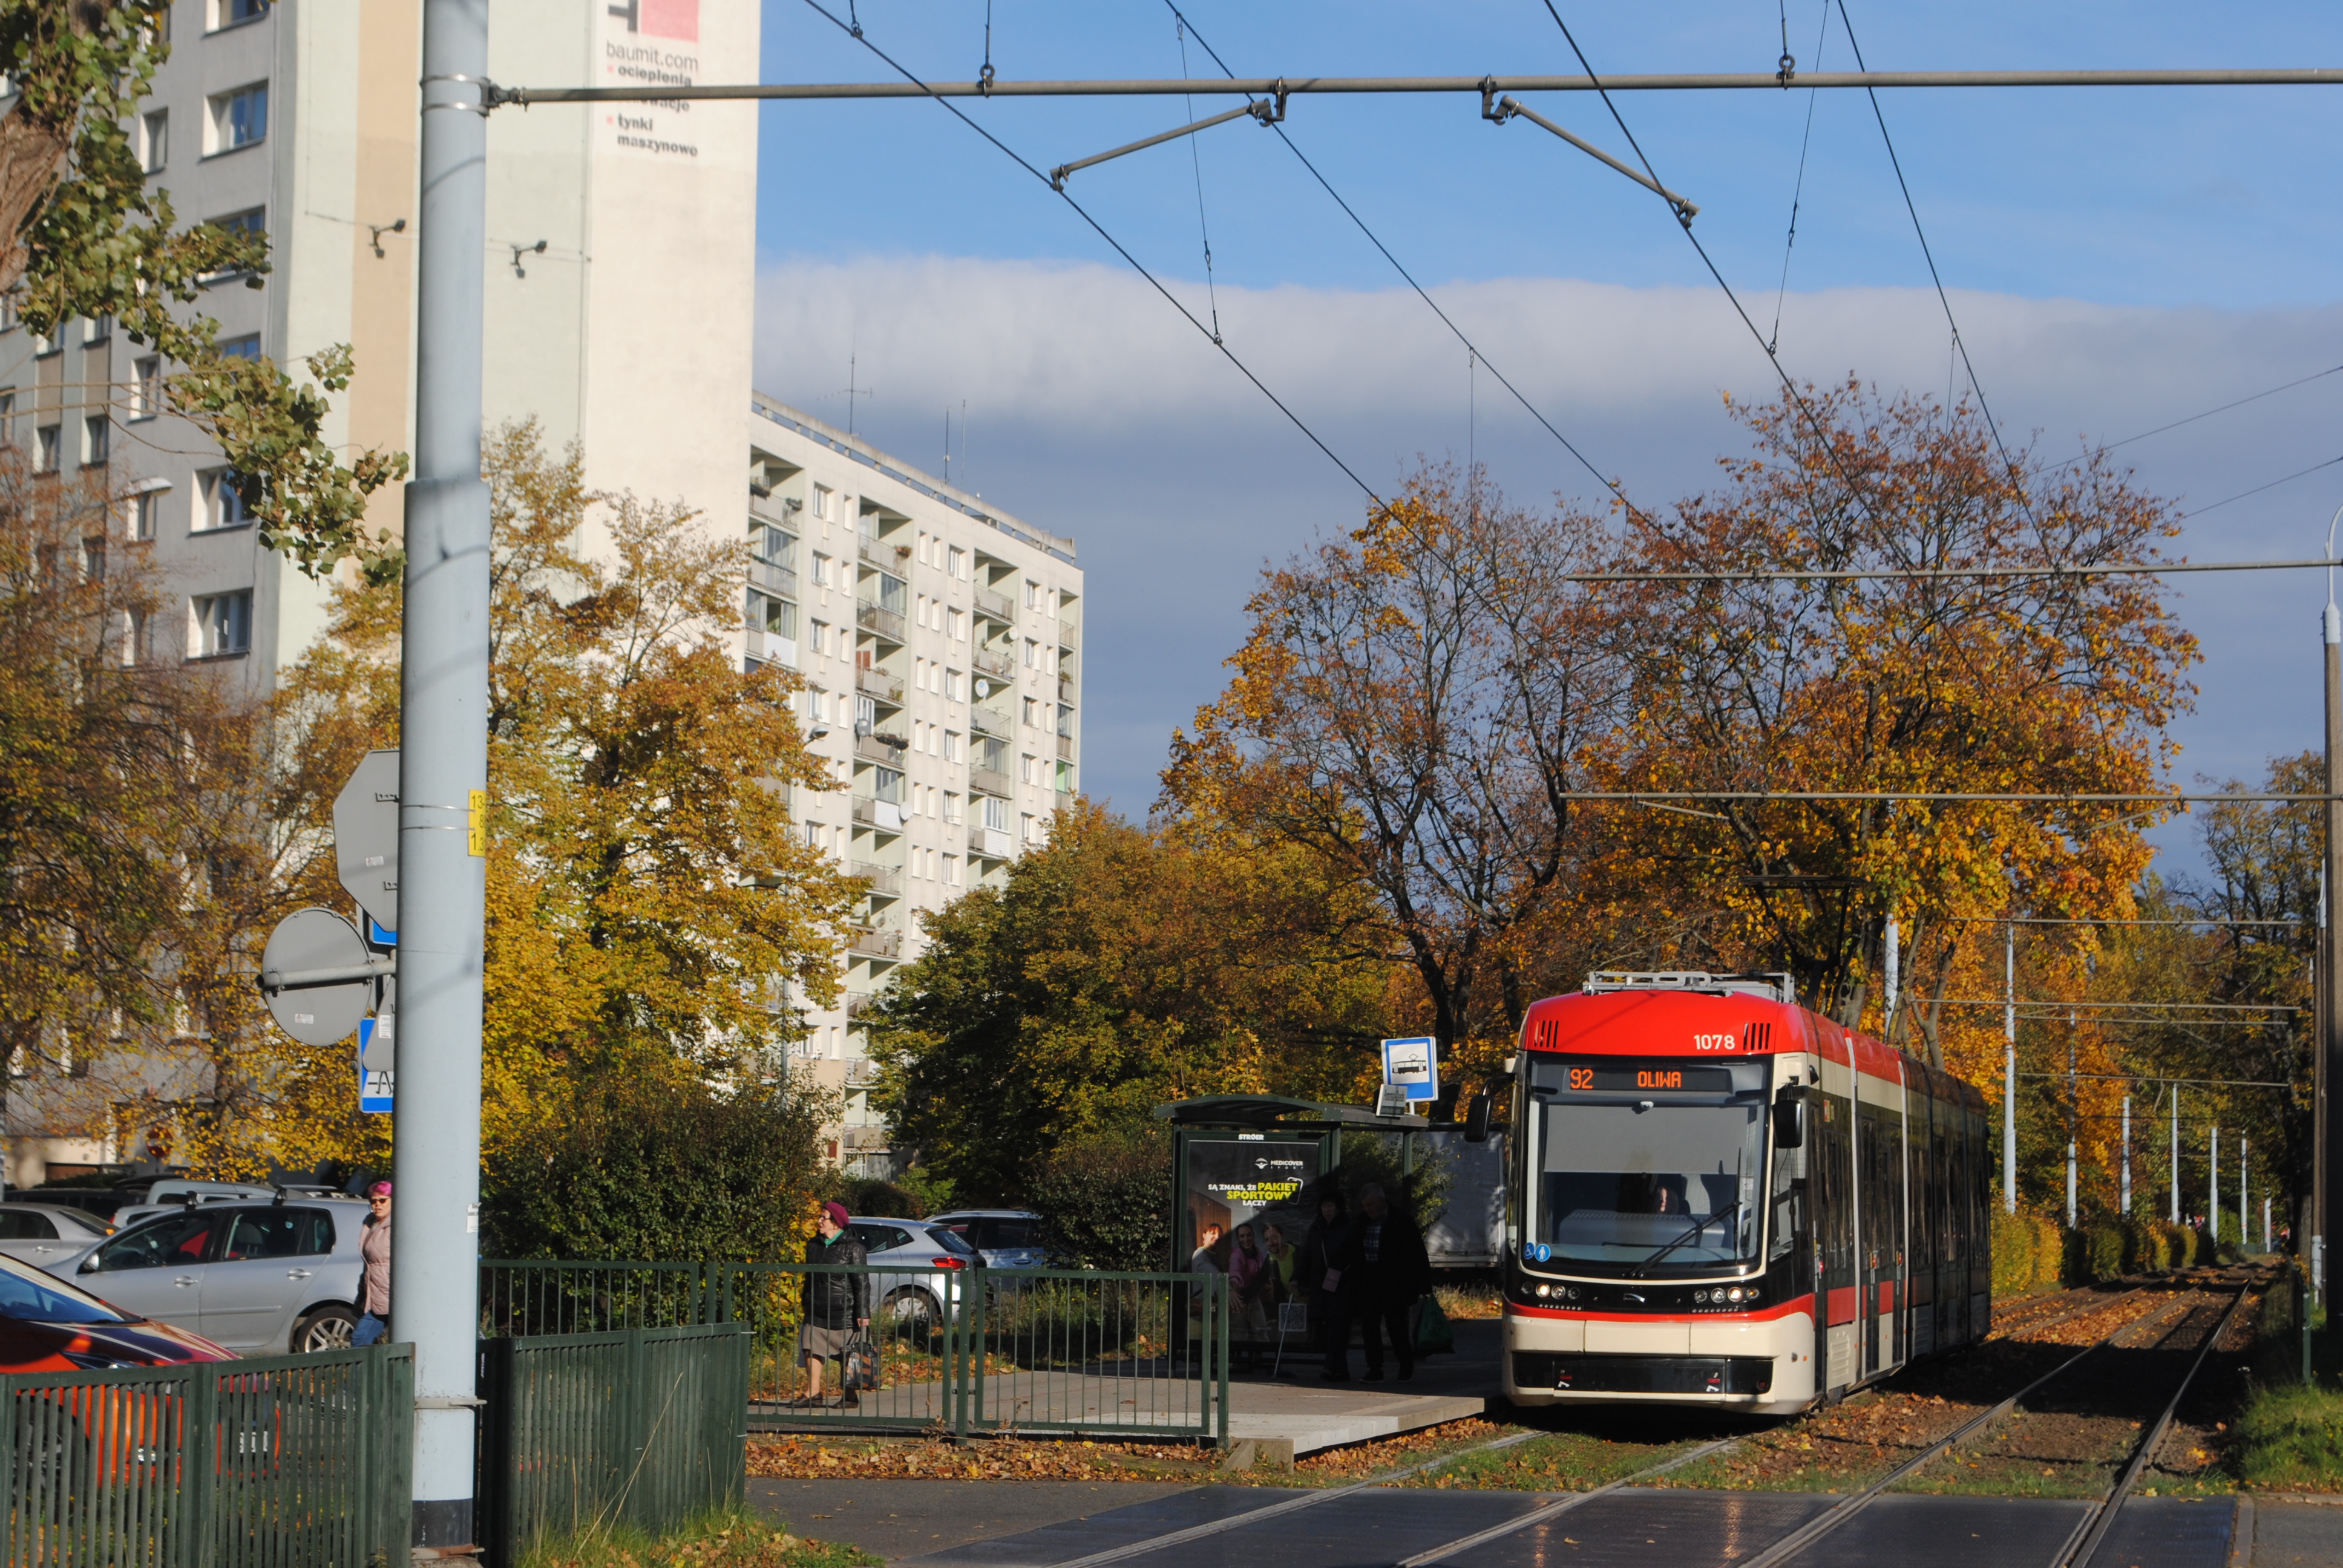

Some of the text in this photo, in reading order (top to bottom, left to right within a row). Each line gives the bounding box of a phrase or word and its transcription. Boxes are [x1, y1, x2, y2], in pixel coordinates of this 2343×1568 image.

[606, 40, 698, 71] baumit.com
[618, 65, 692, 87] ocieplenia
[617, 113, 653, 131] tynki
[617, 134, 698, 156] maszynowe
[1694, 1034, 1735, 1050] 1078
[1570, 1068, 1681, 1089] 92 OLIWA
[1227, 1191, 1293, 1200] SPORTOWY
[1257, 1182, 1298, 1191] PAKIET
